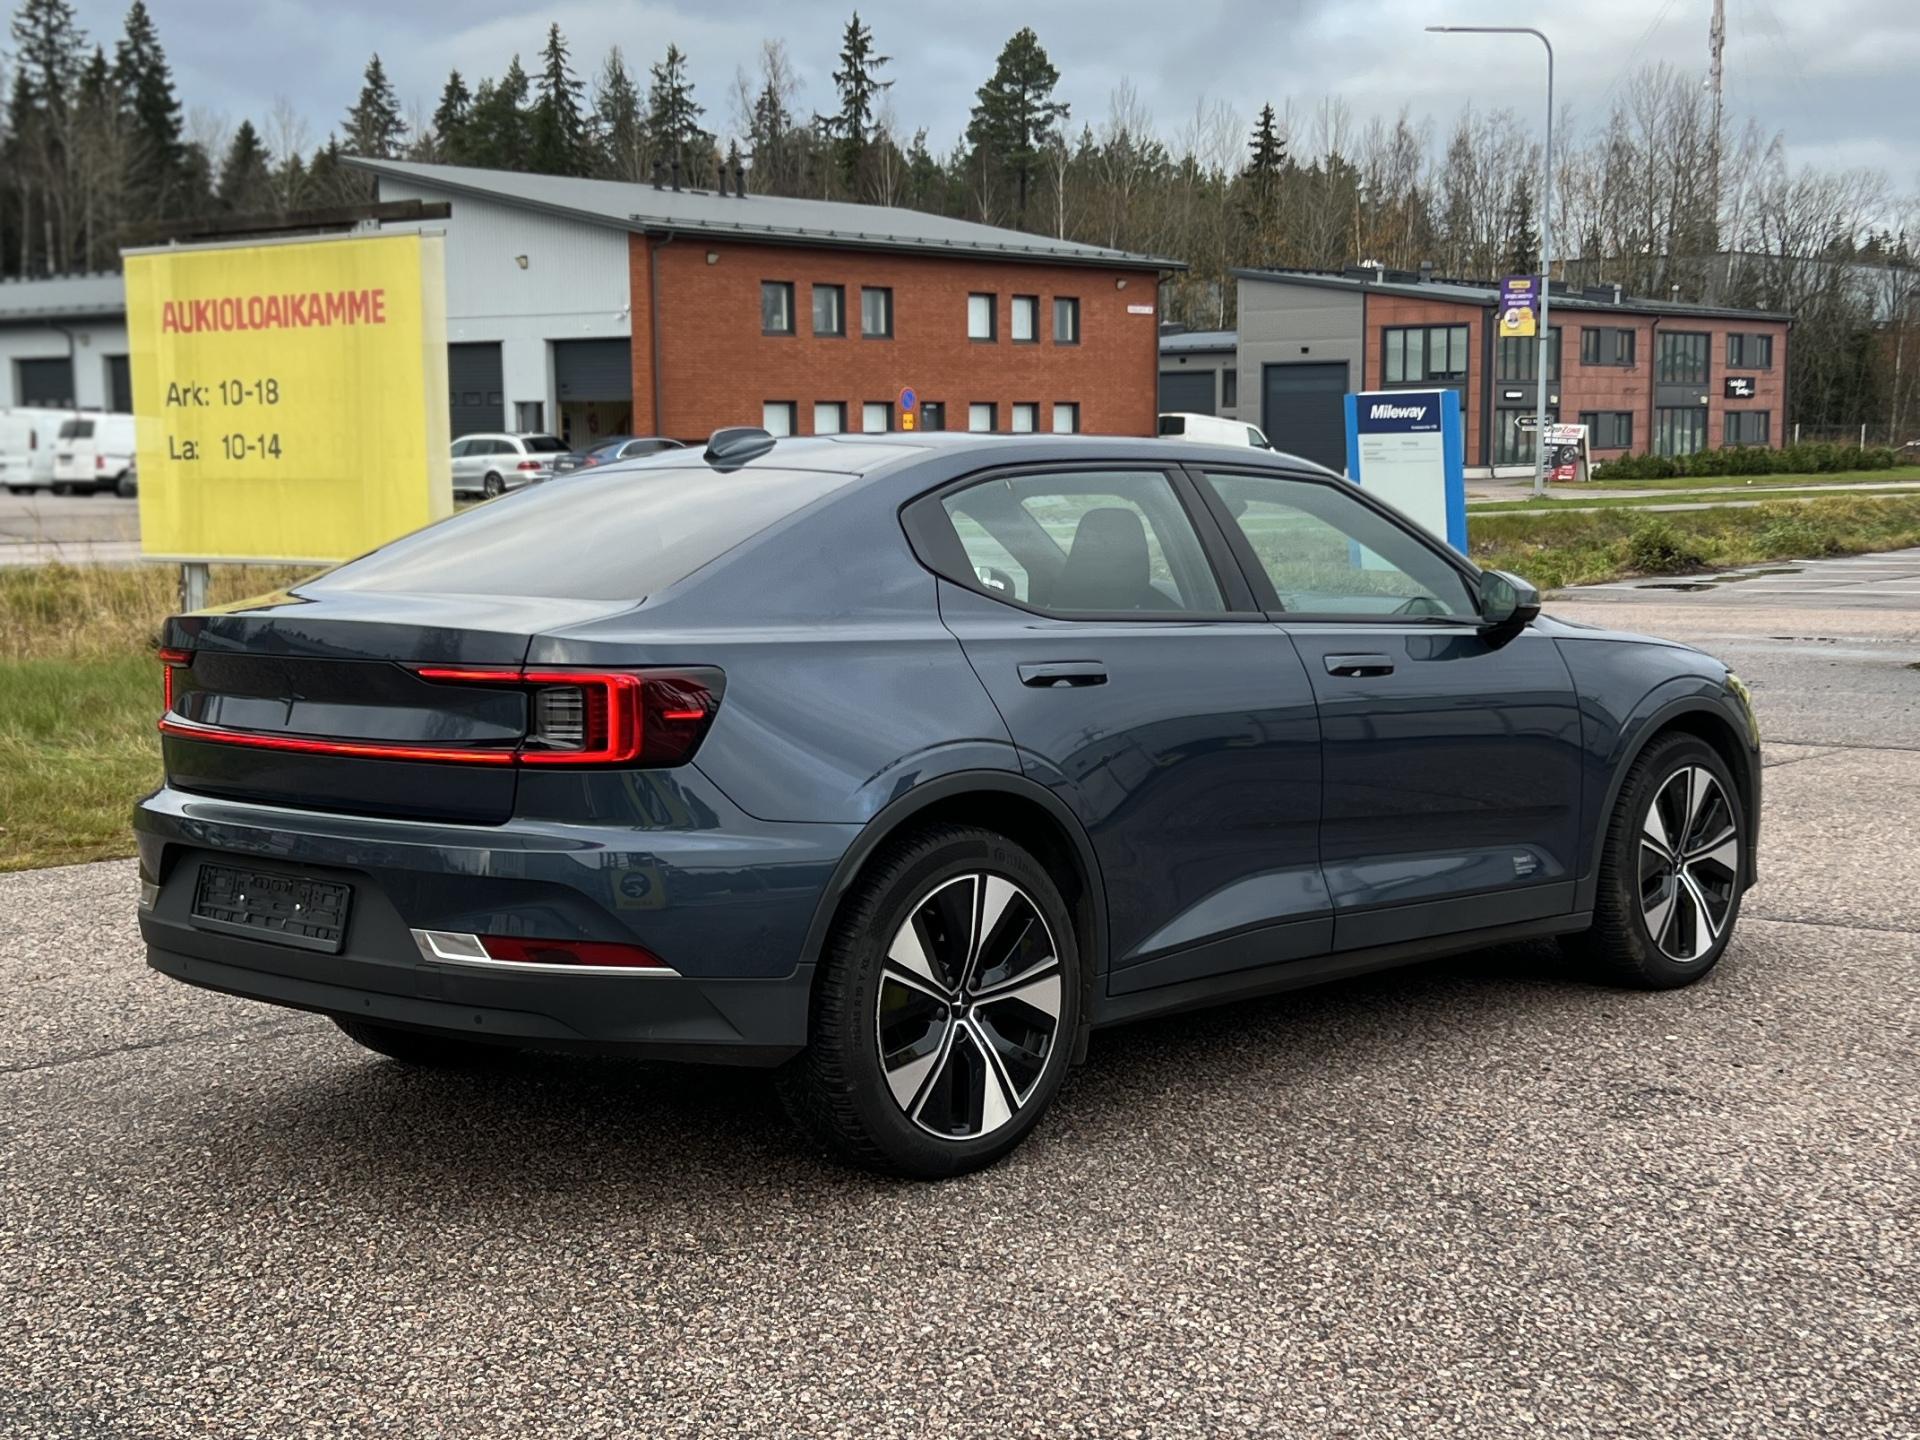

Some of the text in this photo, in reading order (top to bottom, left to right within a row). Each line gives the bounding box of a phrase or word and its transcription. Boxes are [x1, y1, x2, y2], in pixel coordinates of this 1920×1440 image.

[162, 289, 386, 334] AUKIOLOAIKAMME
[166, 378, 280, 407] Ark: 10-18
[1370, 404, 1427, 421] Mileway
[169, 433, 282, 461] La: 10-14
